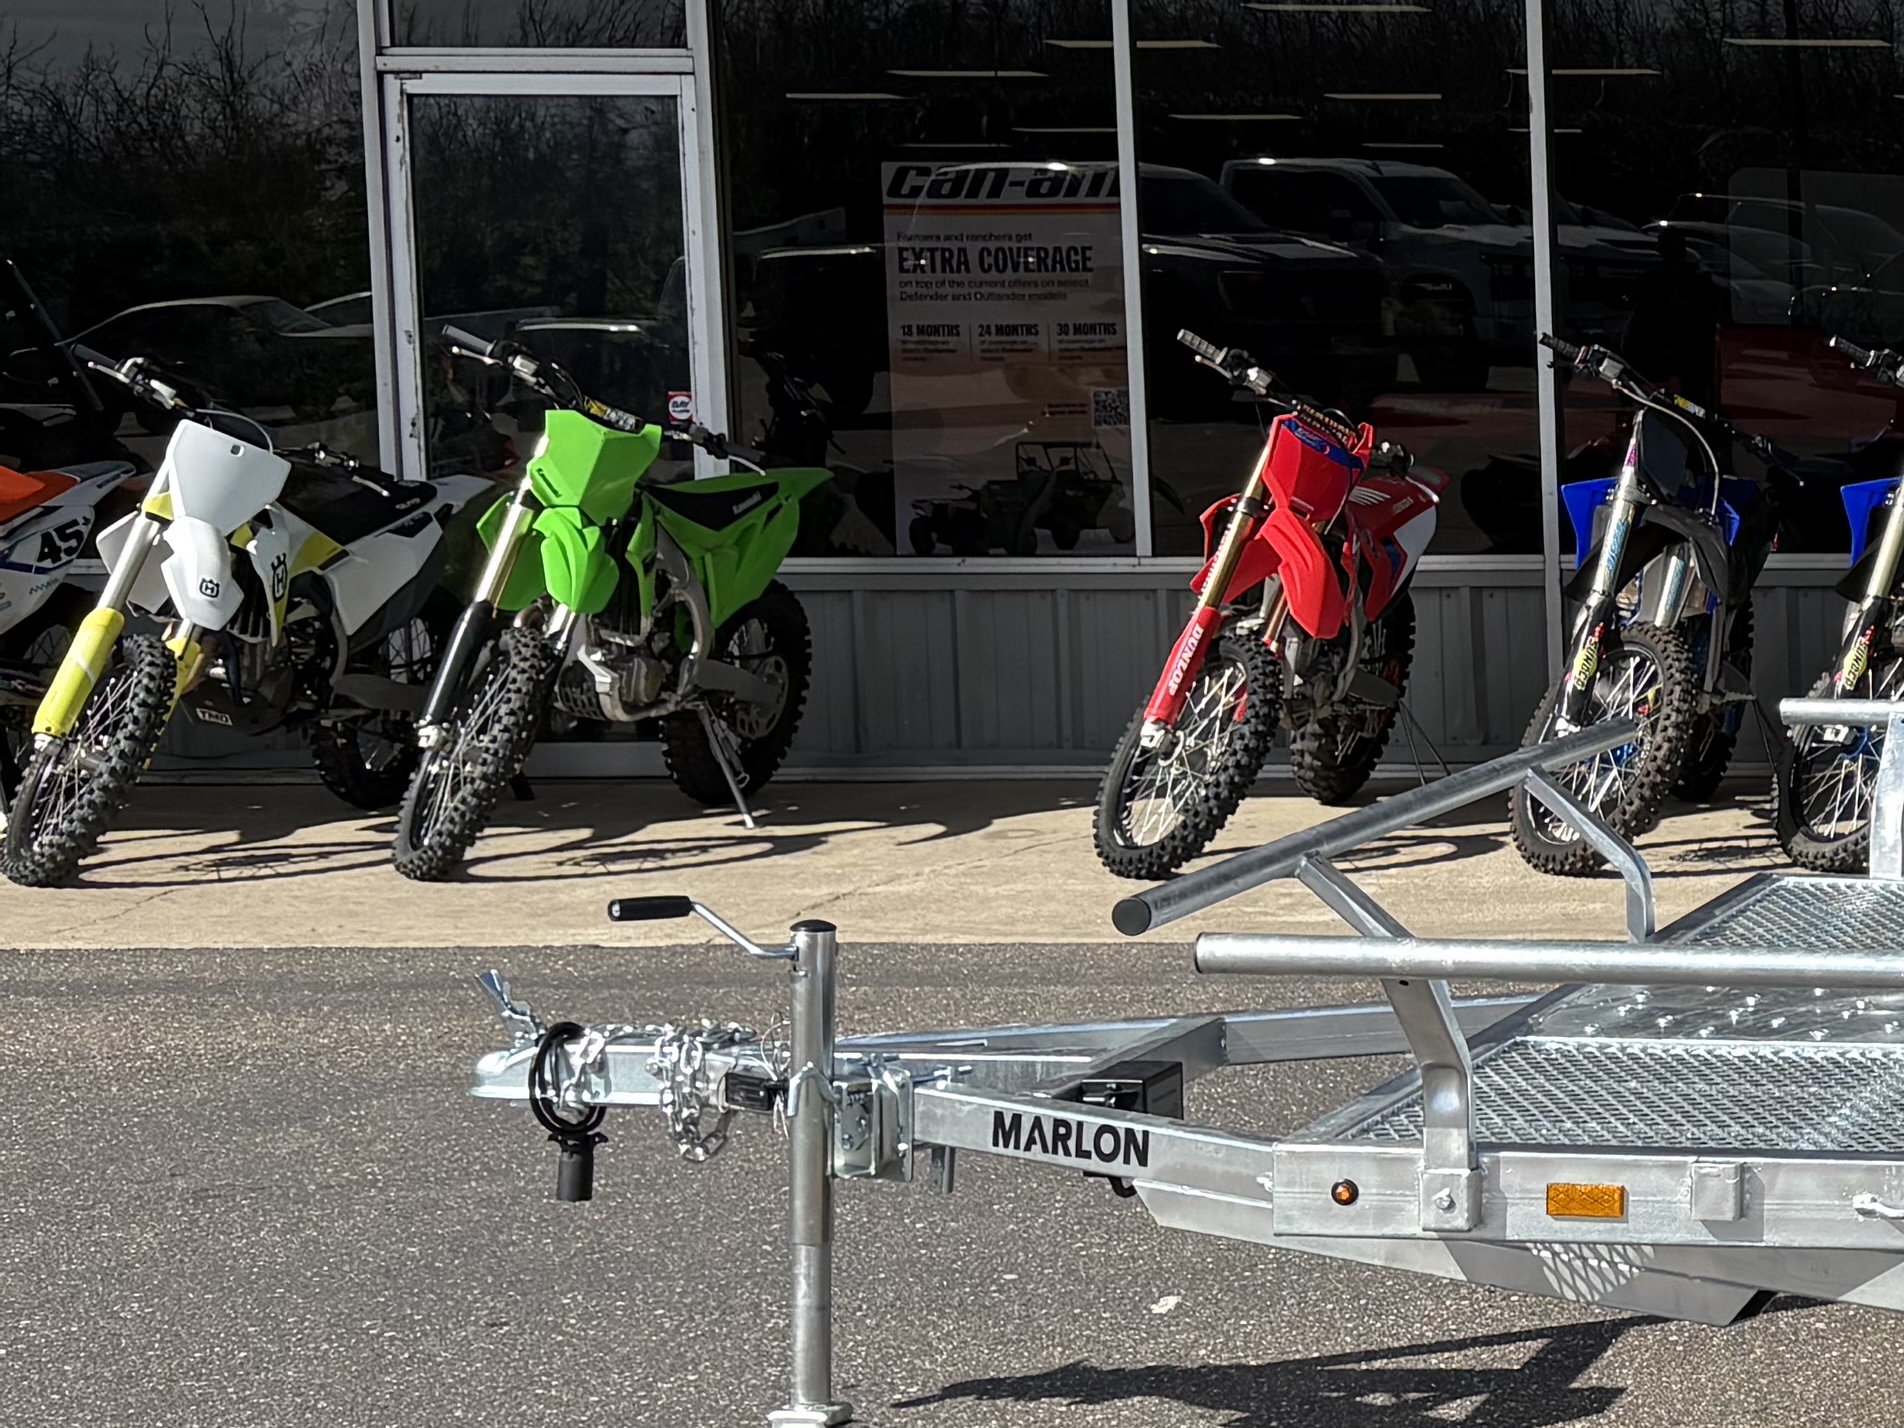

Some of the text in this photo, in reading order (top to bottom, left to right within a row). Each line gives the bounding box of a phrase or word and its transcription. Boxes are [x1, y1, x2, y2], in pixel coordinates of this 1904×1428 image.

[898, 245, 1094, 274] EXTRA COVERAGE
[902, 324, 961, 337] 18 MONTHS
[978, 324, 1039, 337] 24 MONTHS
[1056, 323, 1118, 336] 30 MONTHS
[37, 519, 84, 565] 45
[1170, 623, 1205, 697] DUNLOP
[992, 1110, 1149, 1167] MARLON
